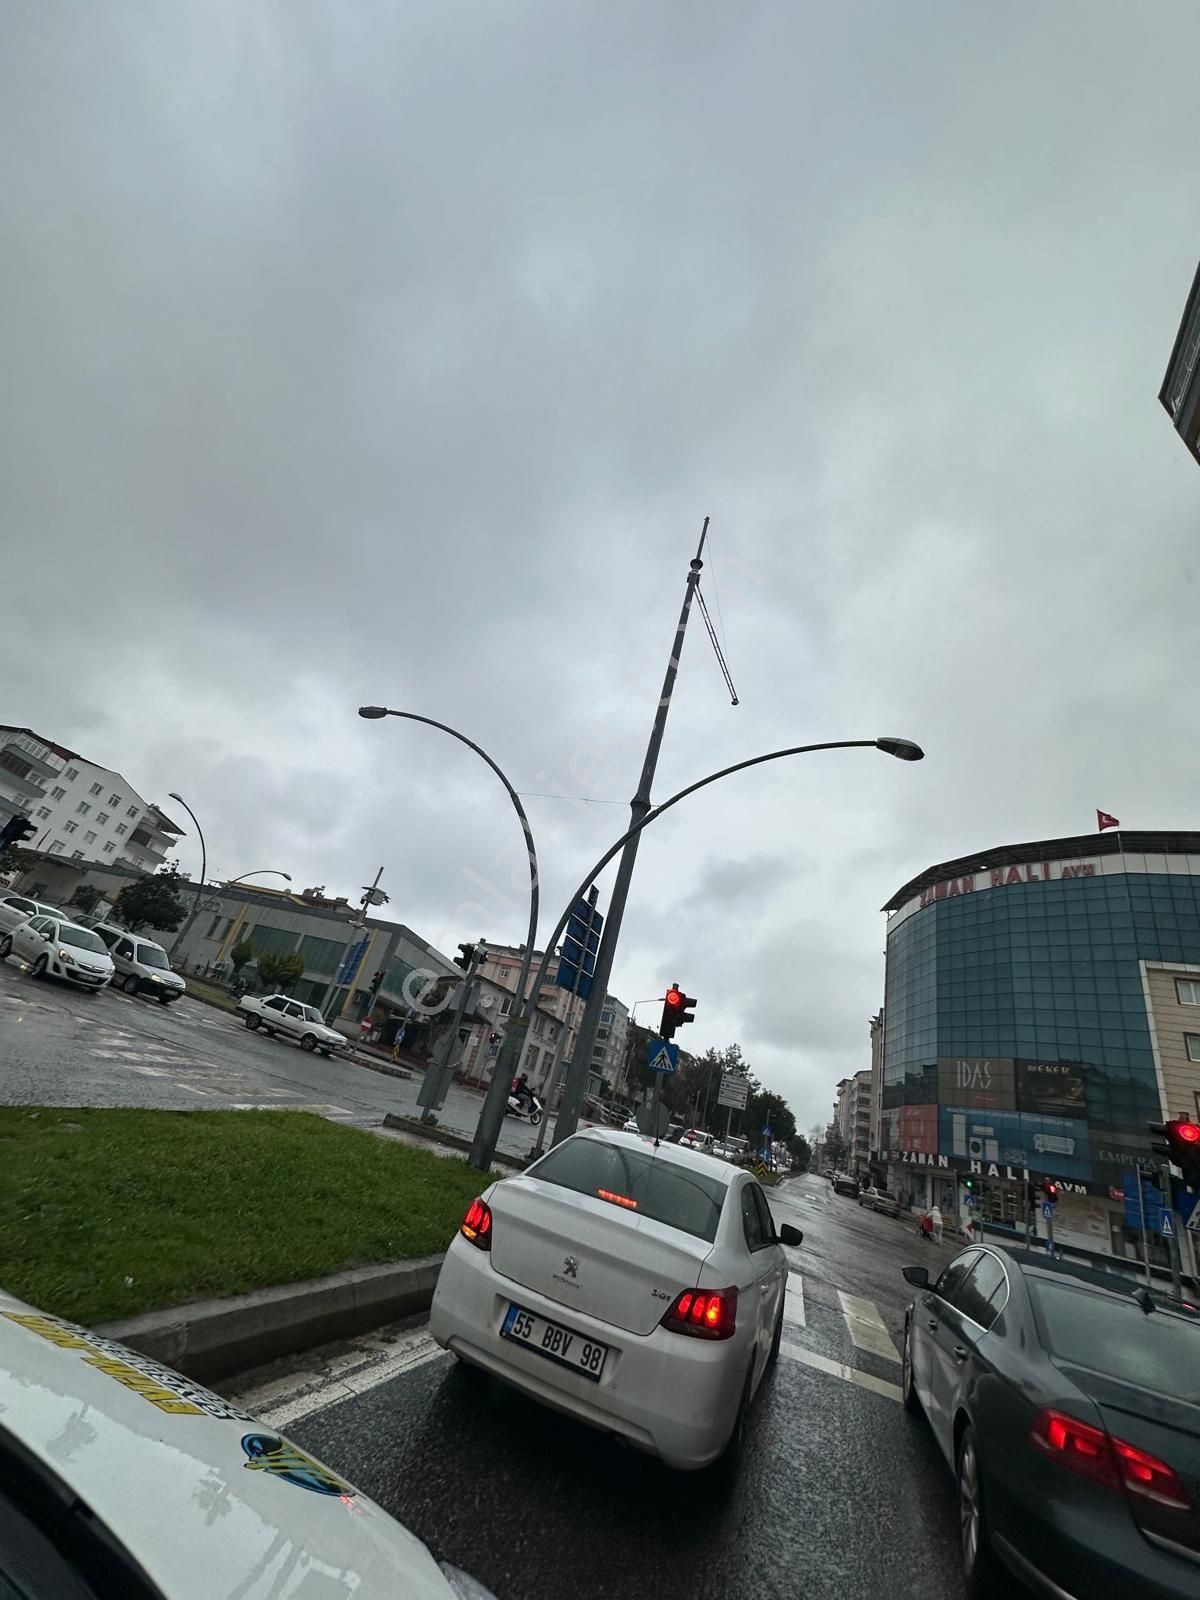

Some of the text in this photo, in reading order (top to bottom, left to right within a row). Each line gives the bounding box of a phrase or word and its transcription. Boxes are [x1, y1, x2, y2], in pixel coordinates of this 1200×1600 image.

[918, 863, 1096, 907] ZAMAN HALI AVM
[902, 1151, 949, 1168] ZAMAN
[969, 1159, 1030, 1183] HALI
[1053, 1180, 1087, 1196] AVM
[513, 1311, 602, 1371] 55 BBV 98
